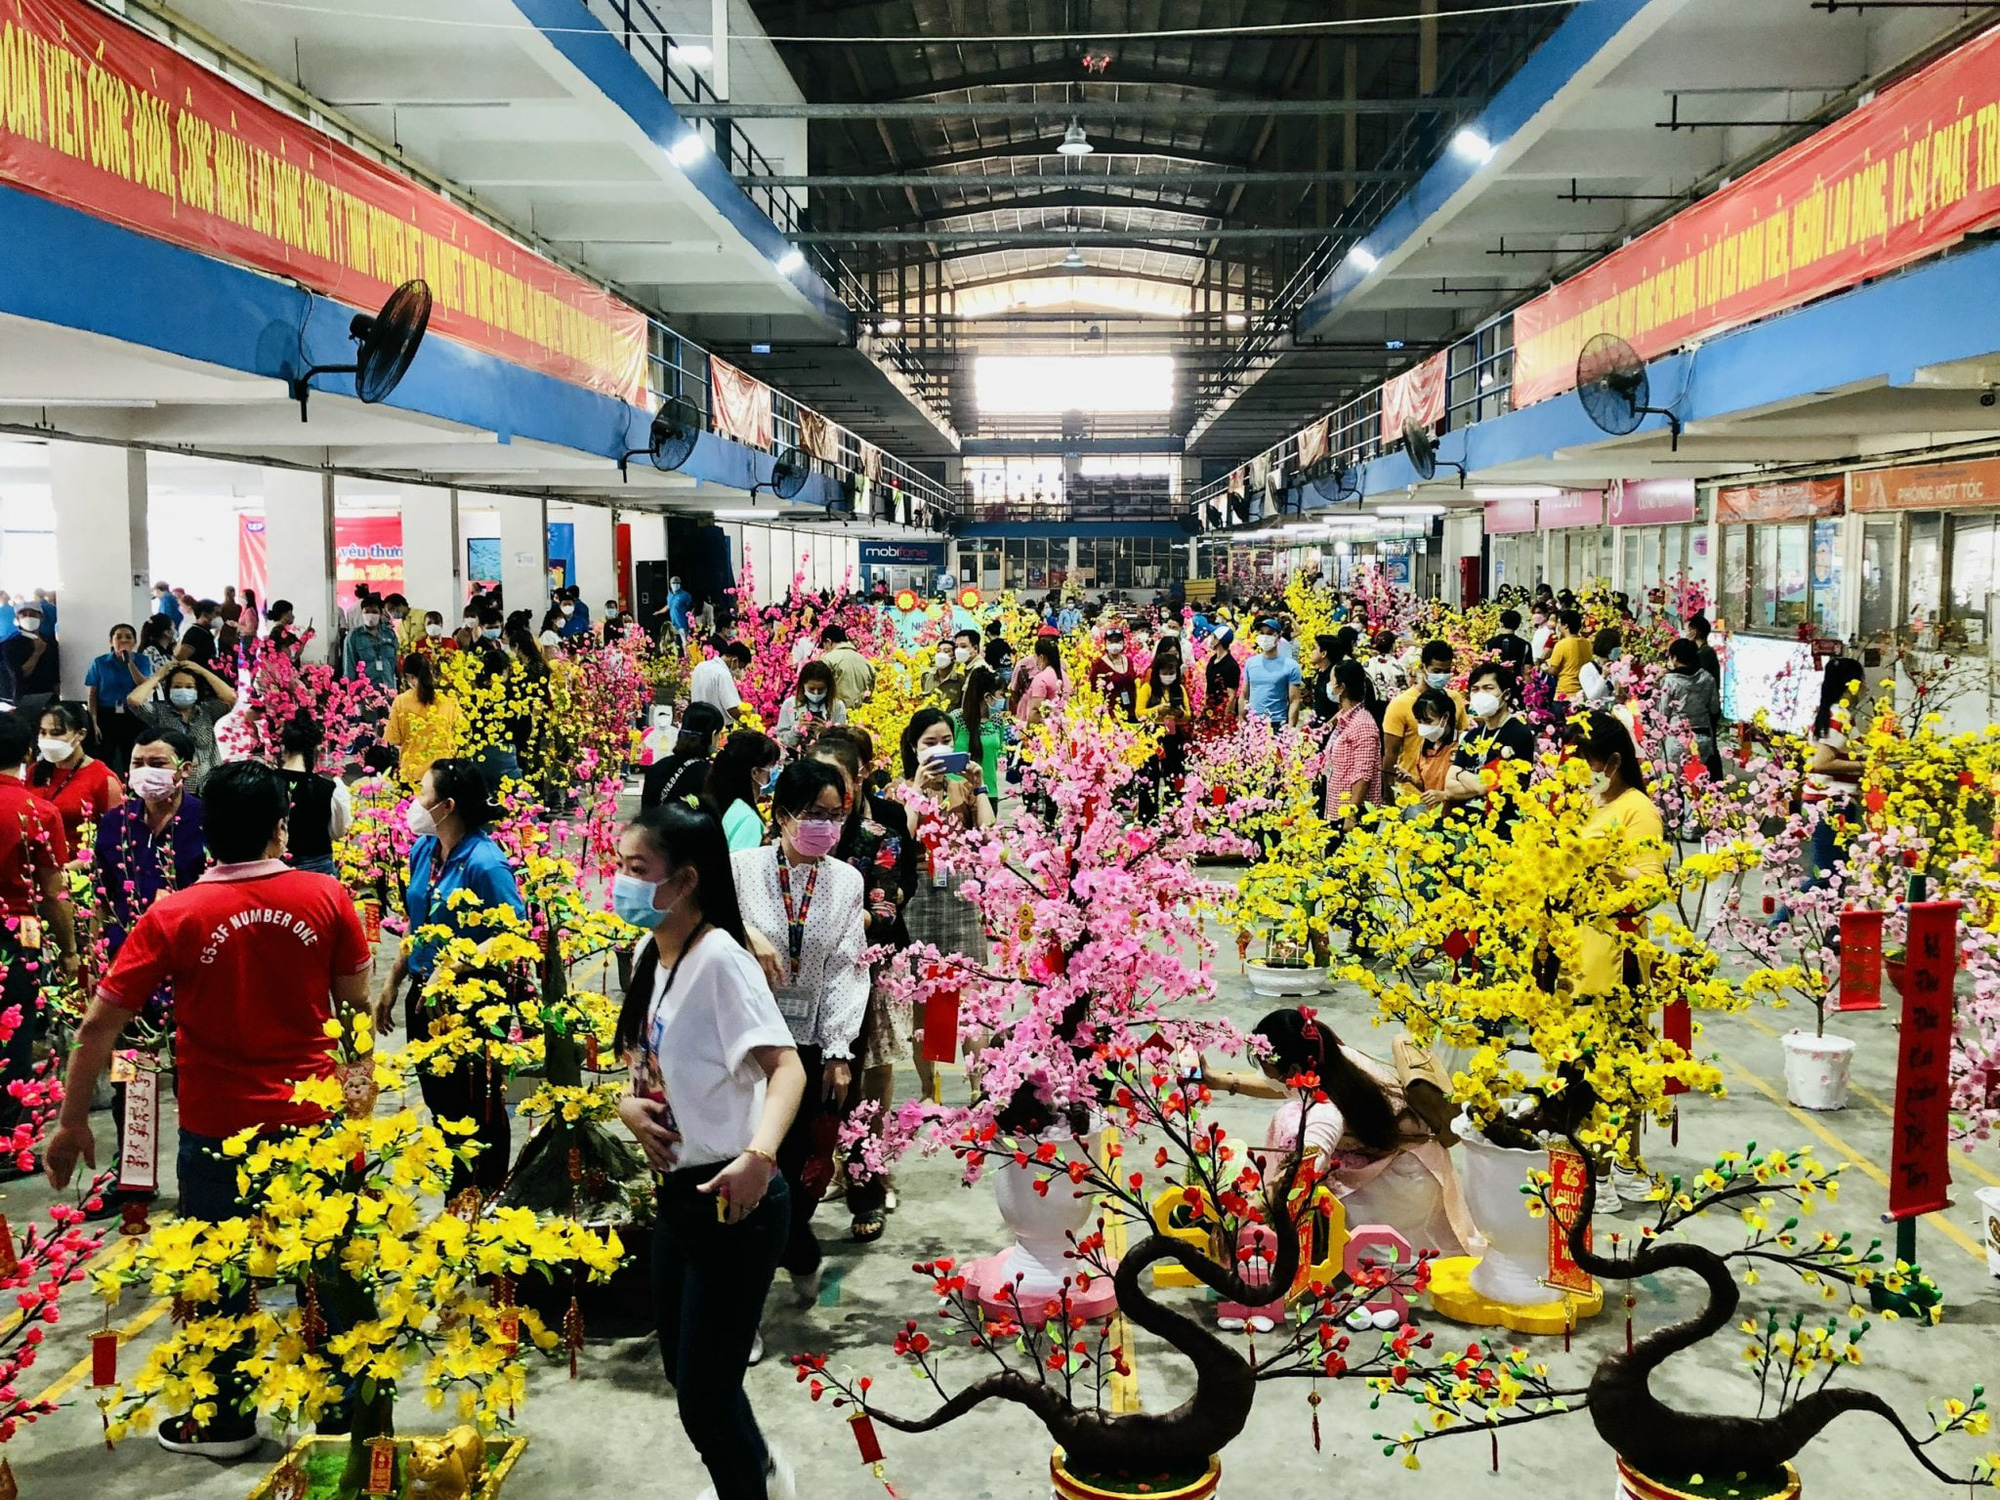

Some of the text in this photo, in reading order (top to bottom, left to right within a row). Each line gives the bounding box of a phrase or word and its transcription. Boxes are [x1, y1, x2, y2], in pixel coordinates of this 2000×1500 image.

[0, 0, 41, 142] OÀN
[43, 19, 86, 160] VIÊN
[87, 39, 131, 181] CÔNG
[177, 86, 214, 215] CÔNG
[214, 110, 249, 228] NHÂN
[249, 144, 273, 238] LAO
[273, 136, 304, 262] ĐỘNG
[304, 151, 331, 261] CÔNG
[1826, 175, 1851, 256] LAO
[1892, 126, 1909, 227] VÌ
[1908, 119, 1933, 235] SỰ
[1931, 95, 1974, 211] PHÁT
[1897, 476, 1985, 502] PHÒNG HỚT TÓC
[865, 545, 928, 558] mobifone
[200, 908, 318, 964] C5-3F NUMBER ONE
